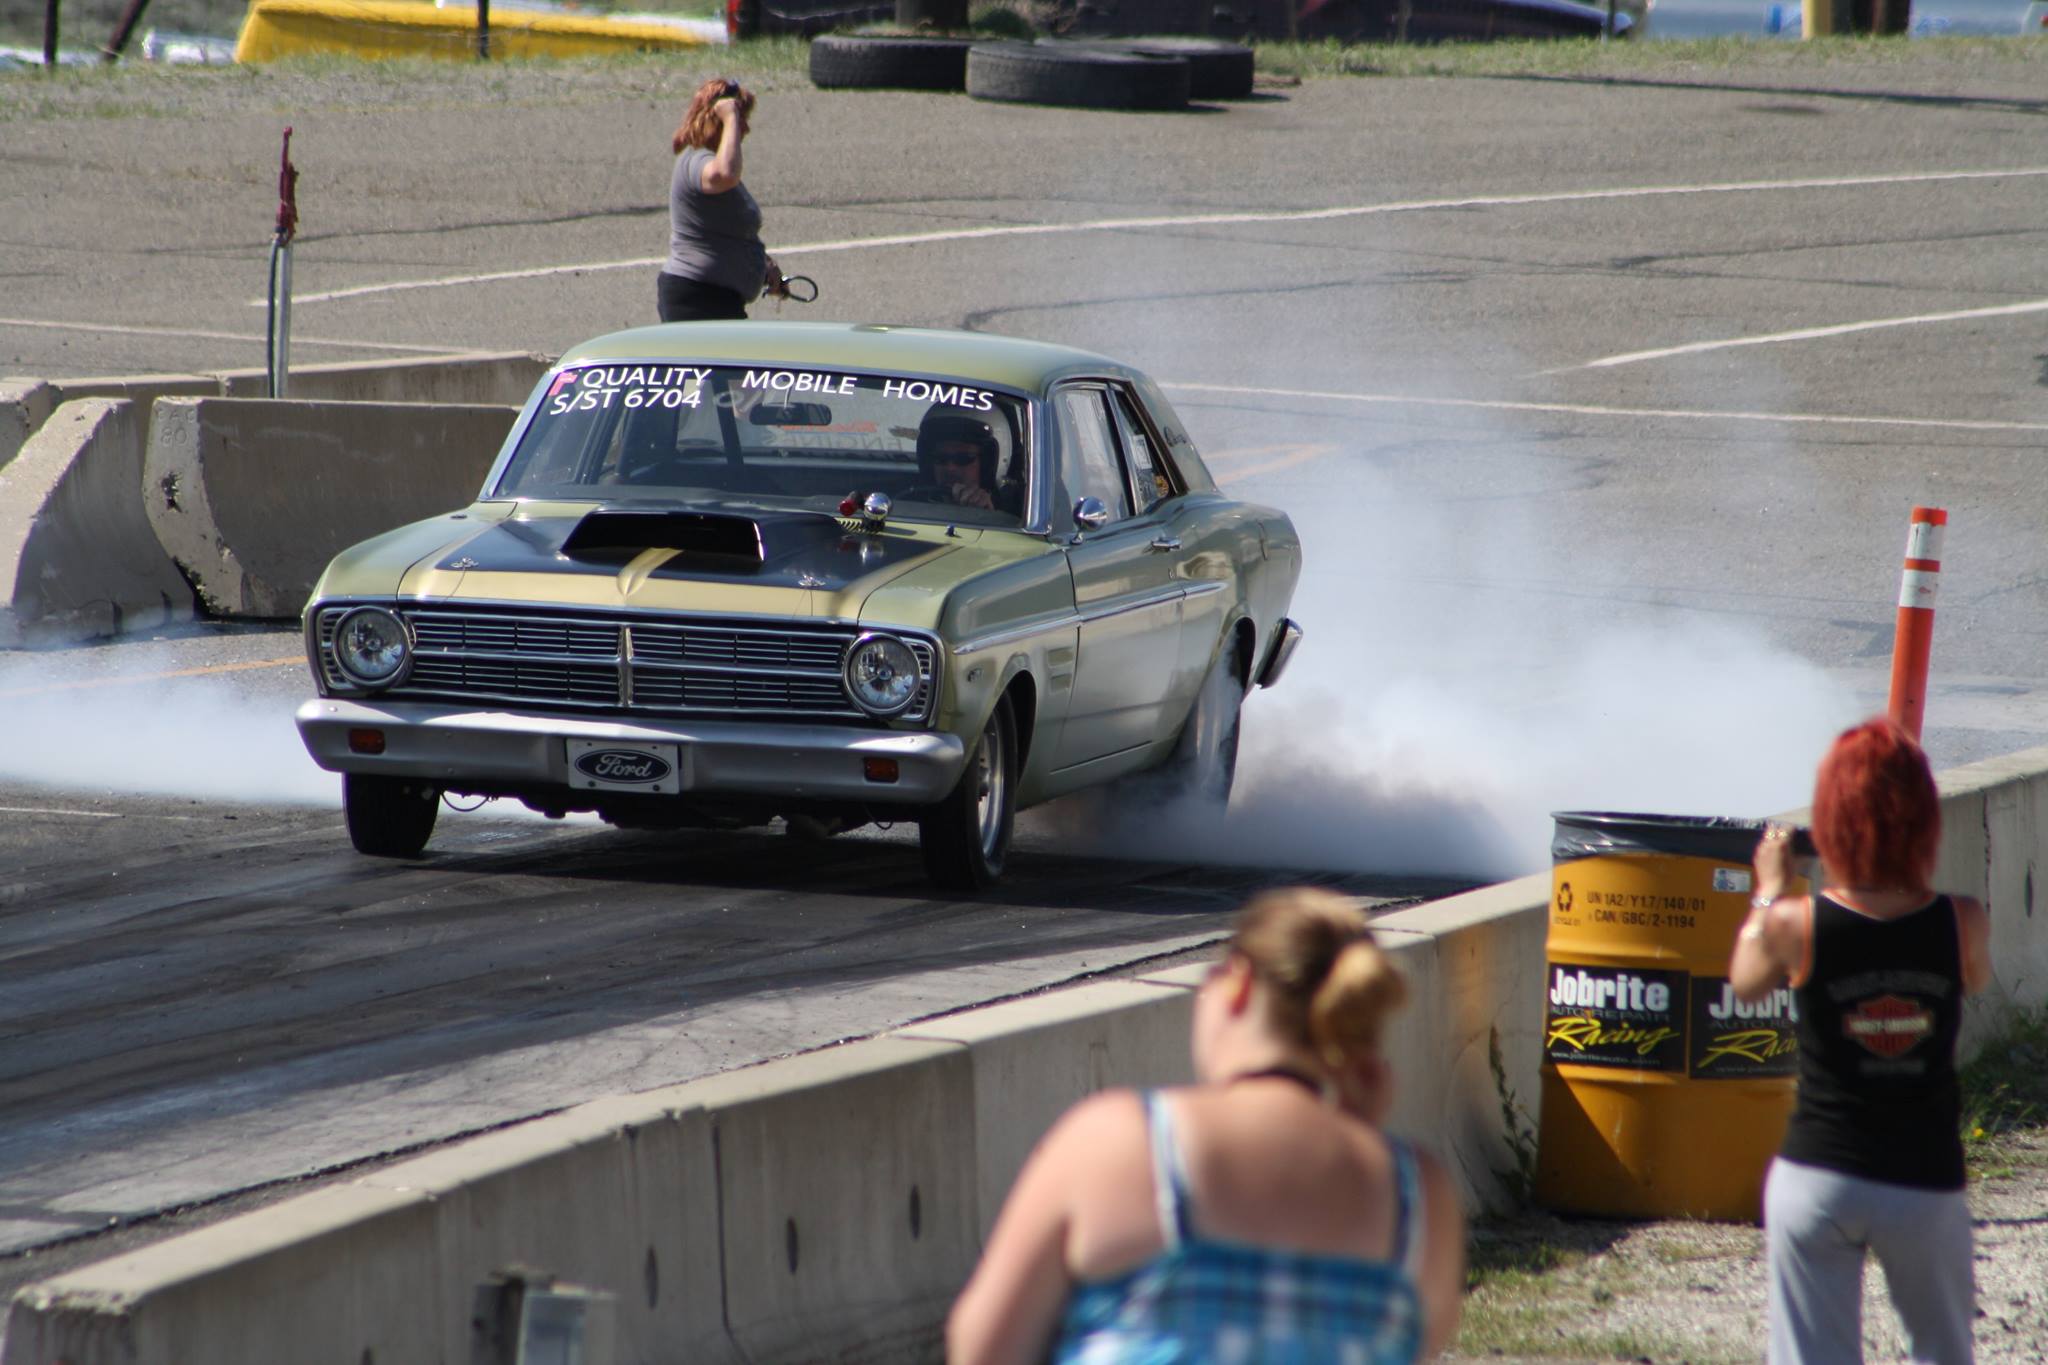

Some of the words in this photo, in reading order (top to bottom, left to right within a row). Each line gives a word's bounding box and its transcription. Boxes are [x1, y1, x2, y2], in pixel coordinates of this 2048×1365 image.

[550, 388, 621, 415] S/ST
[624, 388, 701, 409] 6704
[582, 367, 712, 389] QUALITY
[741, 369, 858, 395] MOBILE
[883, 379, 994, 411] HOMES
[595, 753, 652, 777] Ford
[1550, 968, 1670, 1012] Jobrite
[1547, 1017, 1680, 1055] Racing
